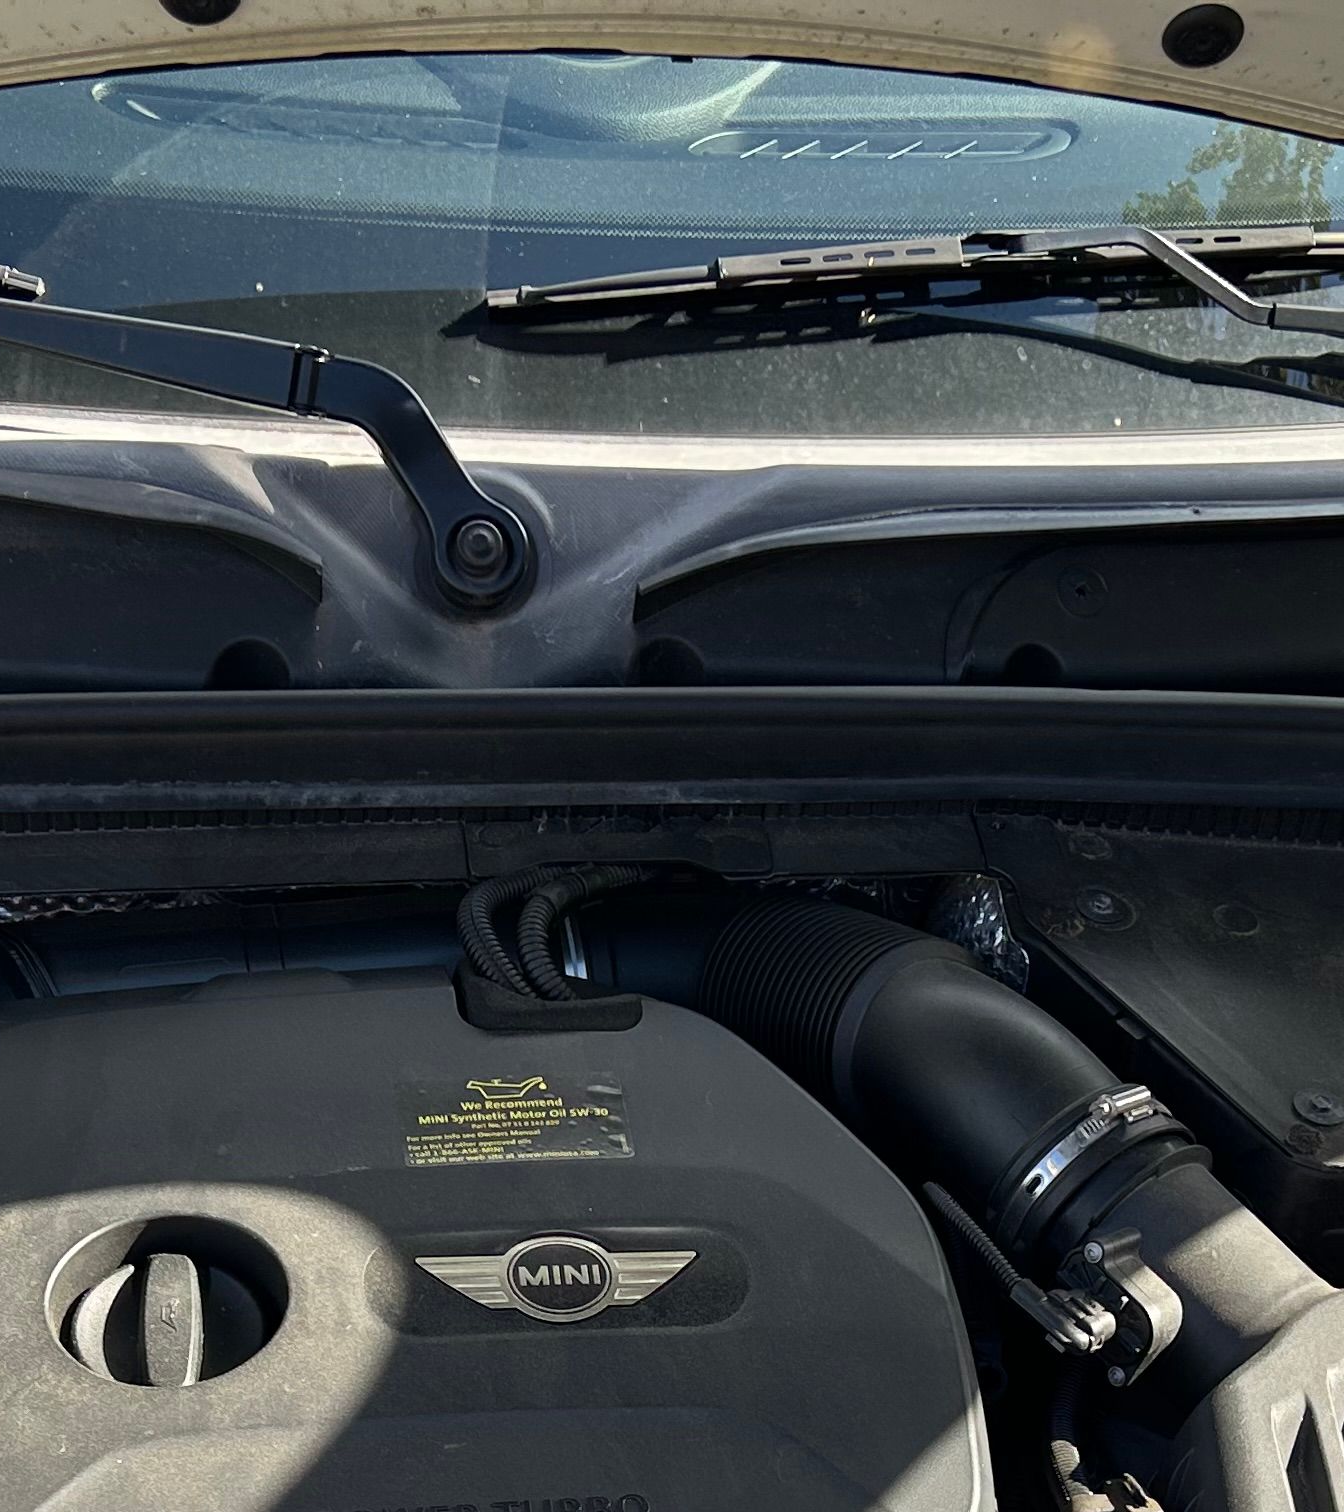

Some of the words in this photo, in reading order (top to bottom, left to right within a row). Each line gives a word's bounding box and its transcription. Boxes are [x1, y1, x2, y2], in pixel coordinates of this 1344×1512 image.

[460, 1101, 482, 1111] We
[484, 1097, 563, 1110] Recommend
[418, 1114, 449, 1125] MINI
[450, 1111, 508, 1124] Synthetic
[509, 1110, 546, 1119] Motor
[549, 1108, 567, 1118] Oil
[569, 1107, 609, 1117] 5W-30
[517, 1263, 602, 1287] MINI
